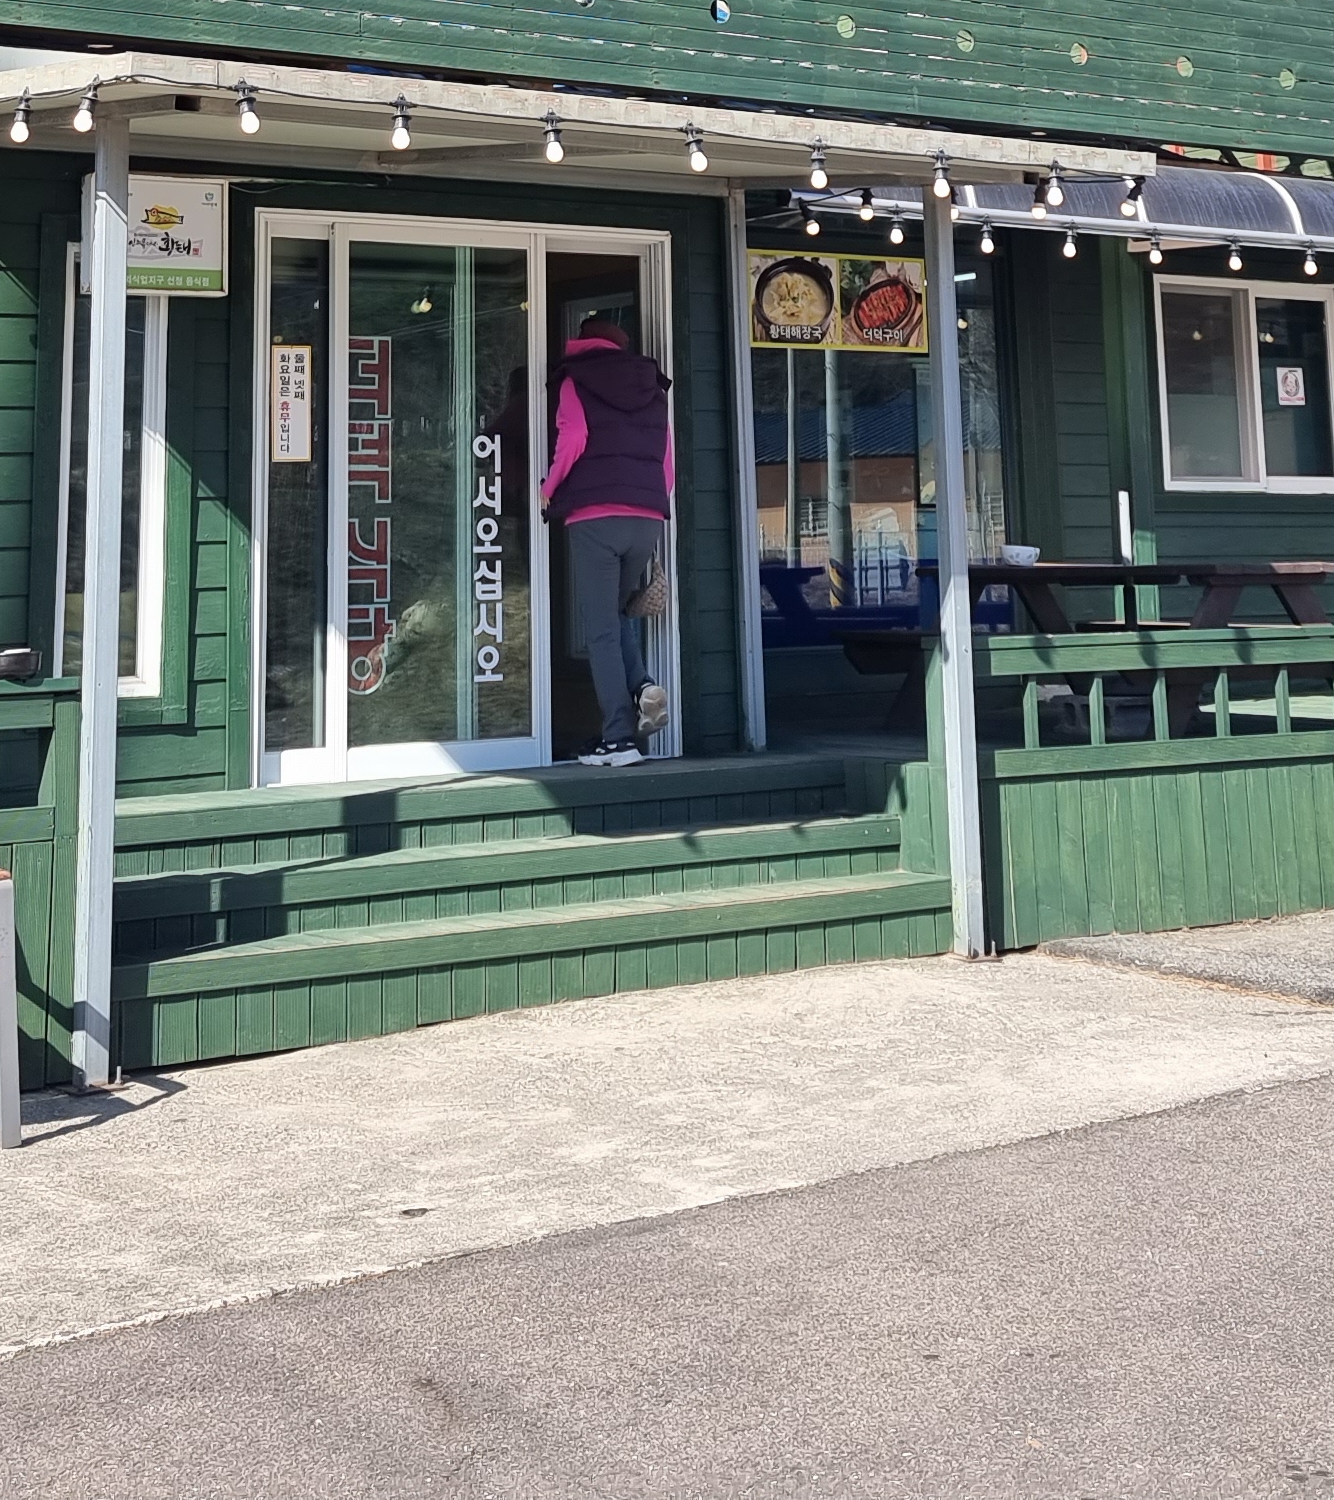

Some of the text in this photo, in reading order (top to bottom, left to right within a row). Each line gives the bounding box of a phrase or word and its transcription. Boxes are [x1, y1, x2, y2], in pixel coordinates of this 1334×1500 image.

[769, 324, 823, 341] 황태해장국
[863, 327, 904, 343] 더덕구이
[293, 353, 305, 376] 둘째
[279, 353, 291, 454] 화요일은 휴무입니다
[472, 434, 504, 684] 어서오십시오
